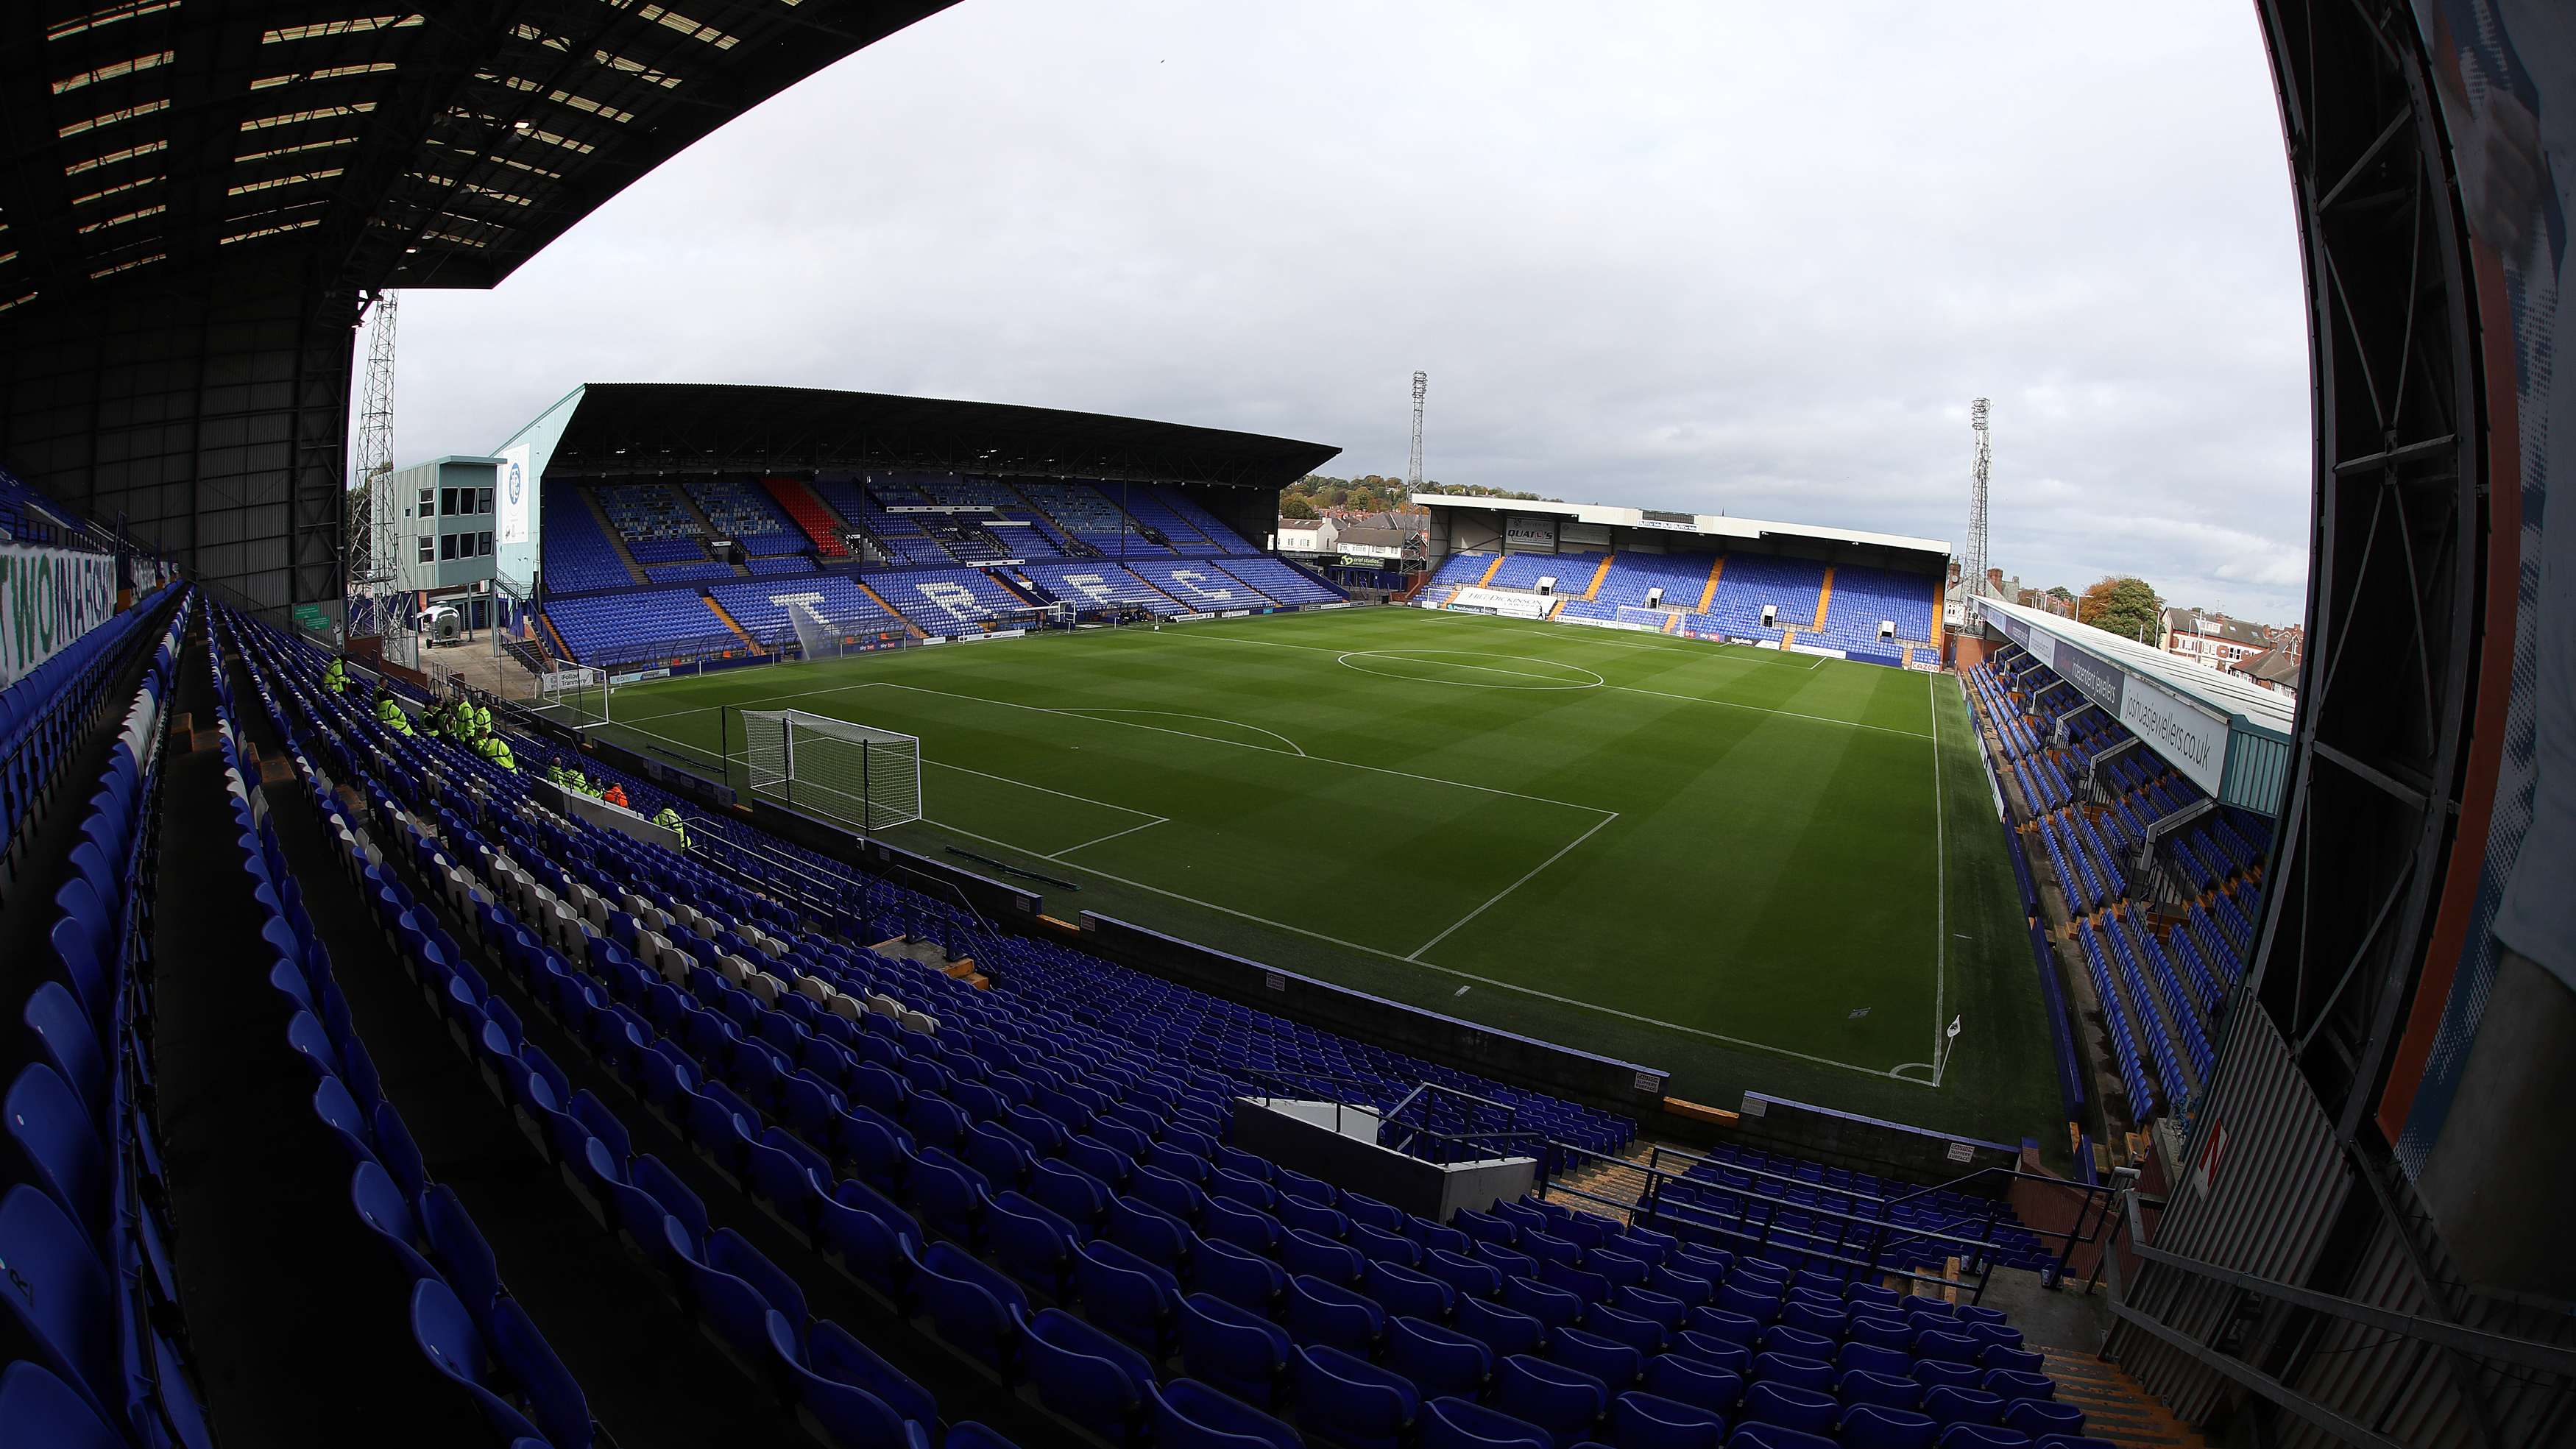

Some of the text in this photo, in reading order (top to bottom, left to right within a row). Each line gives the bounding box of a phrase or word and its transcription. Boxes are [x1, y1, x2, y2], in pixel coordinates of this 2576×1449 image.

[1507, 529, 1554, 539] QUAIL'S
[1912, 662, 1939, 672] CAZOO
[2072, 656, 2096, 690] independent
[2093, 670, 2116, 704] jewellers
[2125, 690, 2210, 771] joshuasjewellers.co.uk
[1637, 1074, 1659, 1083] CAUTION
[1951, 1144, 1973, 1153] CAUTION
